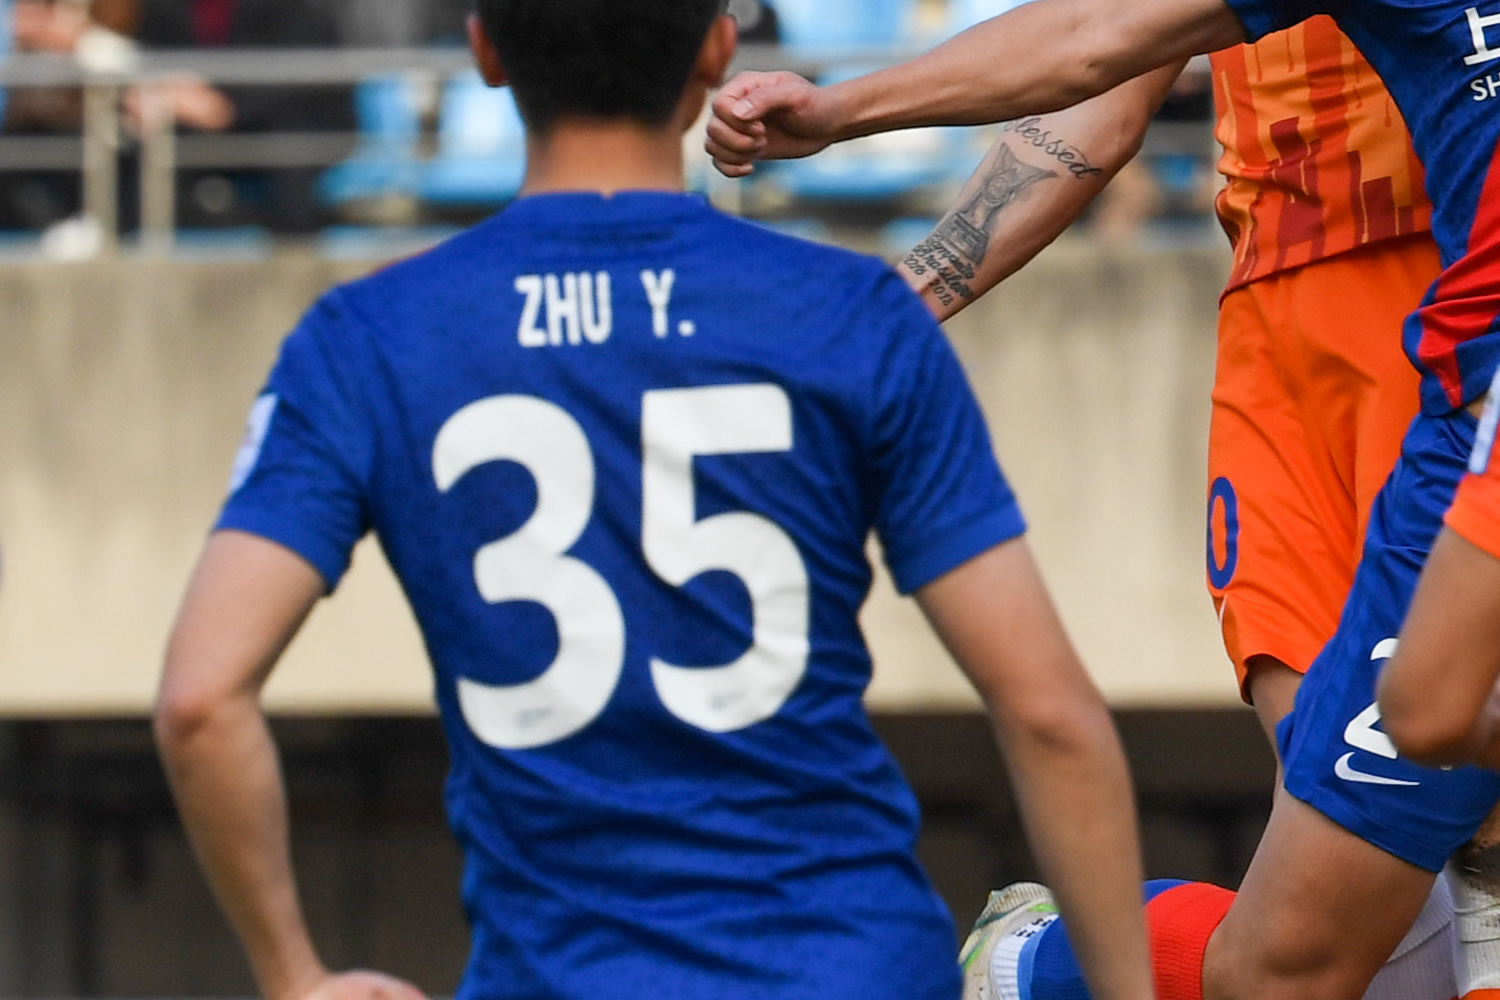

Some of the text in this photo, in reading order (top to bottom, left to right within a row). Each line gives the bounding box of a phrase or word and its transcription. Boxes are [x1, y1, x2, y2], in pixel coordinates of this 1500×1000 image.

[515, 270, 696, 347] ZHU Y.
[432, 383, 810, 749] 35
